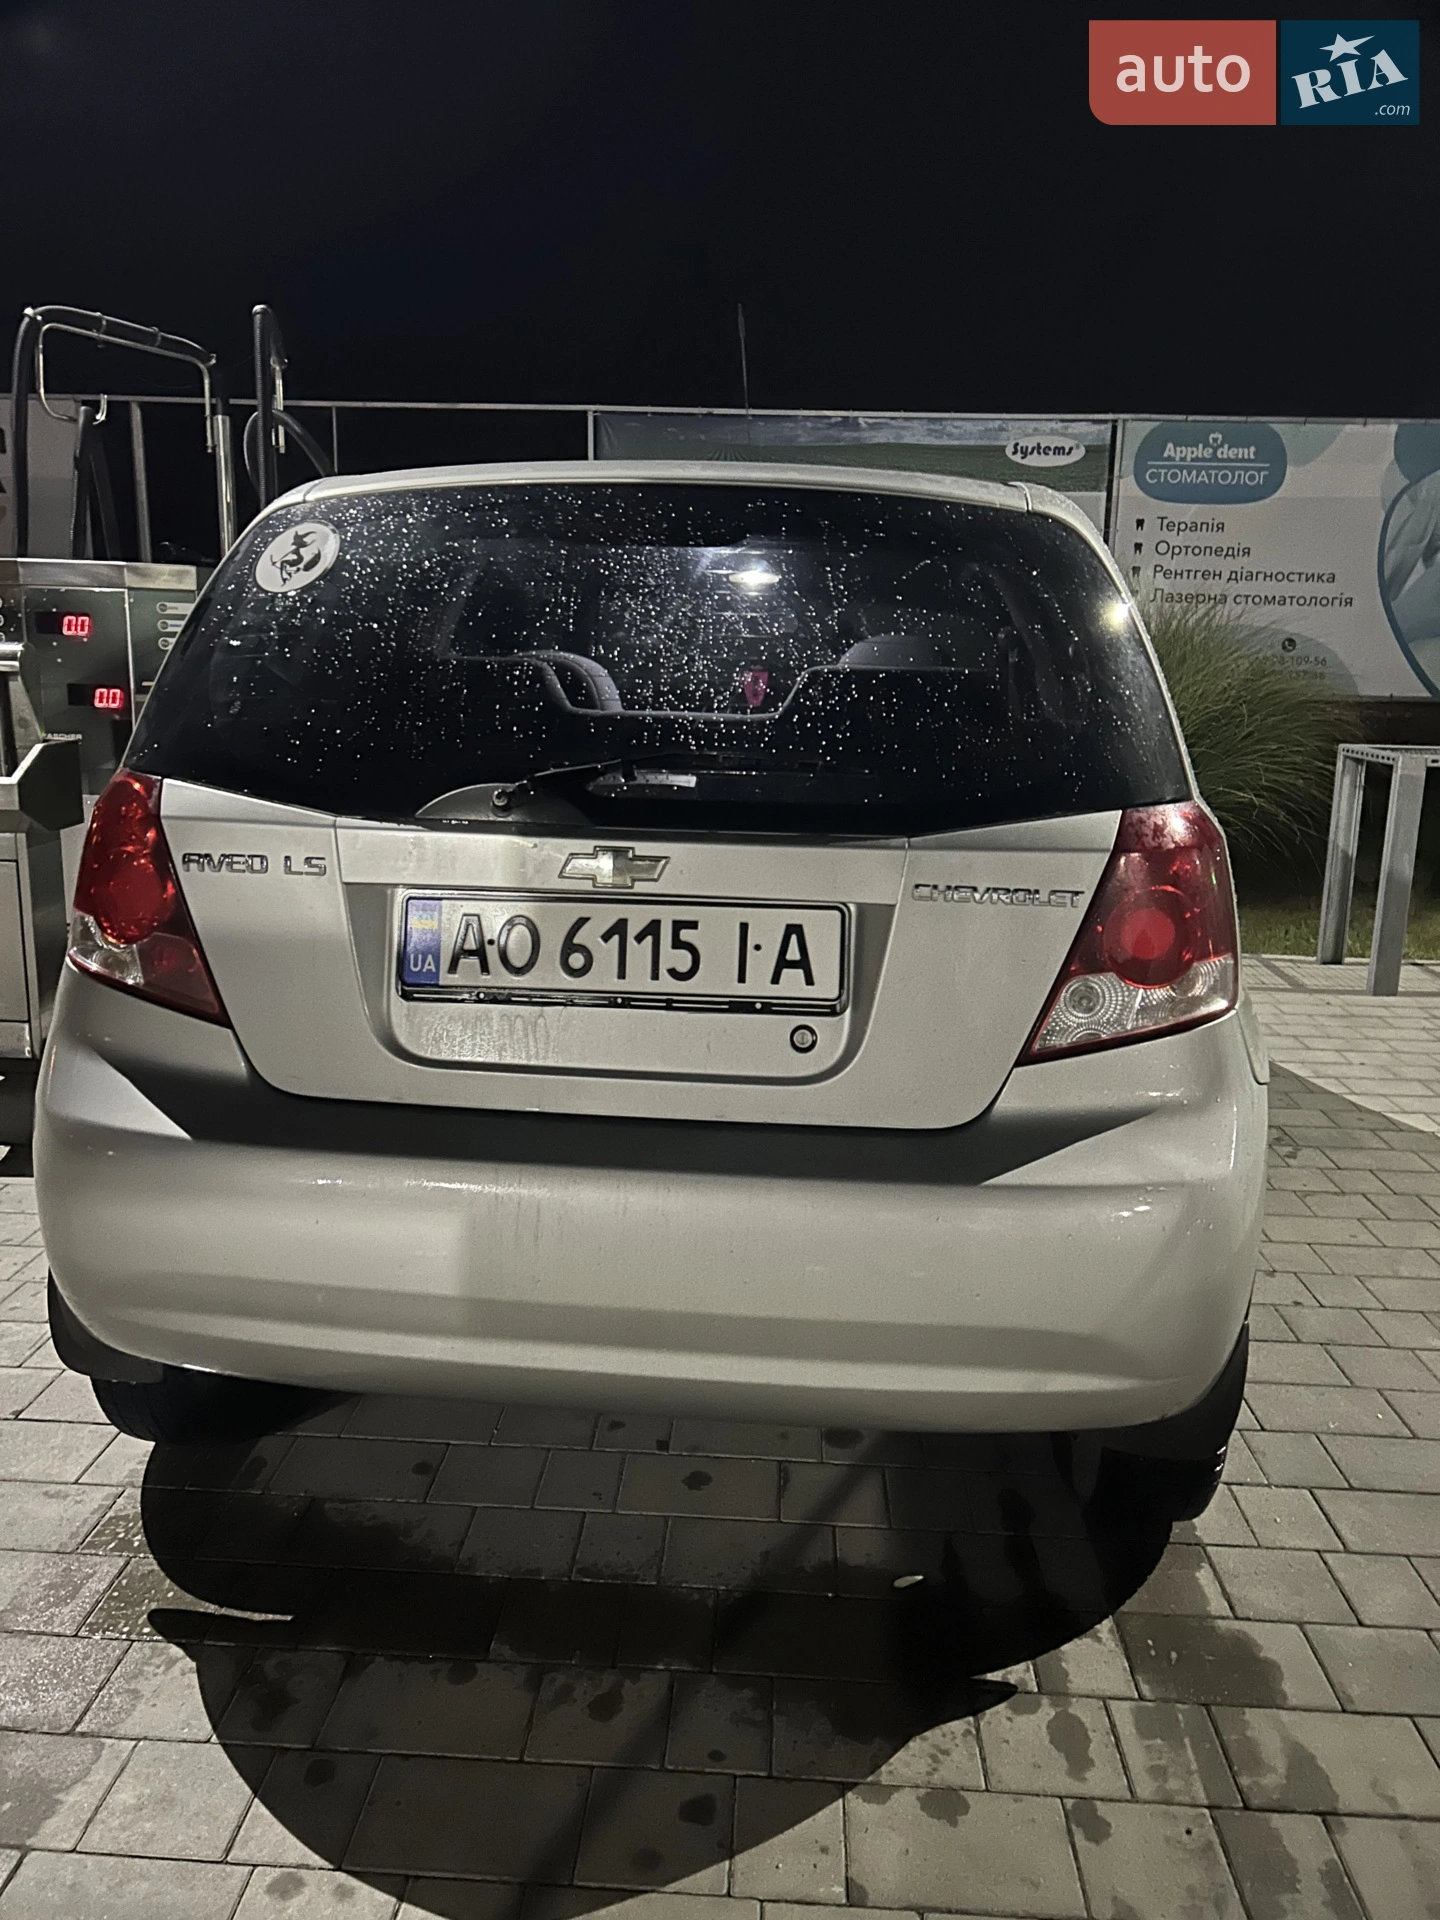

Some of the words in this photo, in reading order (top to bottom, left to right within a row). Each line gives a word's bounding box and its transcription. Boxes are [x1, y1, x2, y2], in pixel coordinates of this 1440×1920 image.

[1011, 441, 1074, 460] Systems
[1163, 442, 1213, 462] Apple
[1216, 443, 1256, 459] dent
[1145, 468, 1269, 486] СТОМАТОЛОГ
[1156, 516, 1225, 536] Терапія
[1154, 540, 1251, 560] Ортопедія
[1153, 564, 1222, 581] Рентген
[1227, 566, 1336, 584] діагностика
[1150, 588, 1228, 607] Лазерна
[1233, 592, 1353, 608] стоматологія
[182, 852, 269, 875] AVEO
[283, 855, 327, 877] LS
[911, 883, 1086, 908] CHEVROLET
[446, 912, 541, 979] AO
[559, 916, 701, 982] 6115
[736, 921, 815, 986] IA
[409, 953, 436, 973] UA
